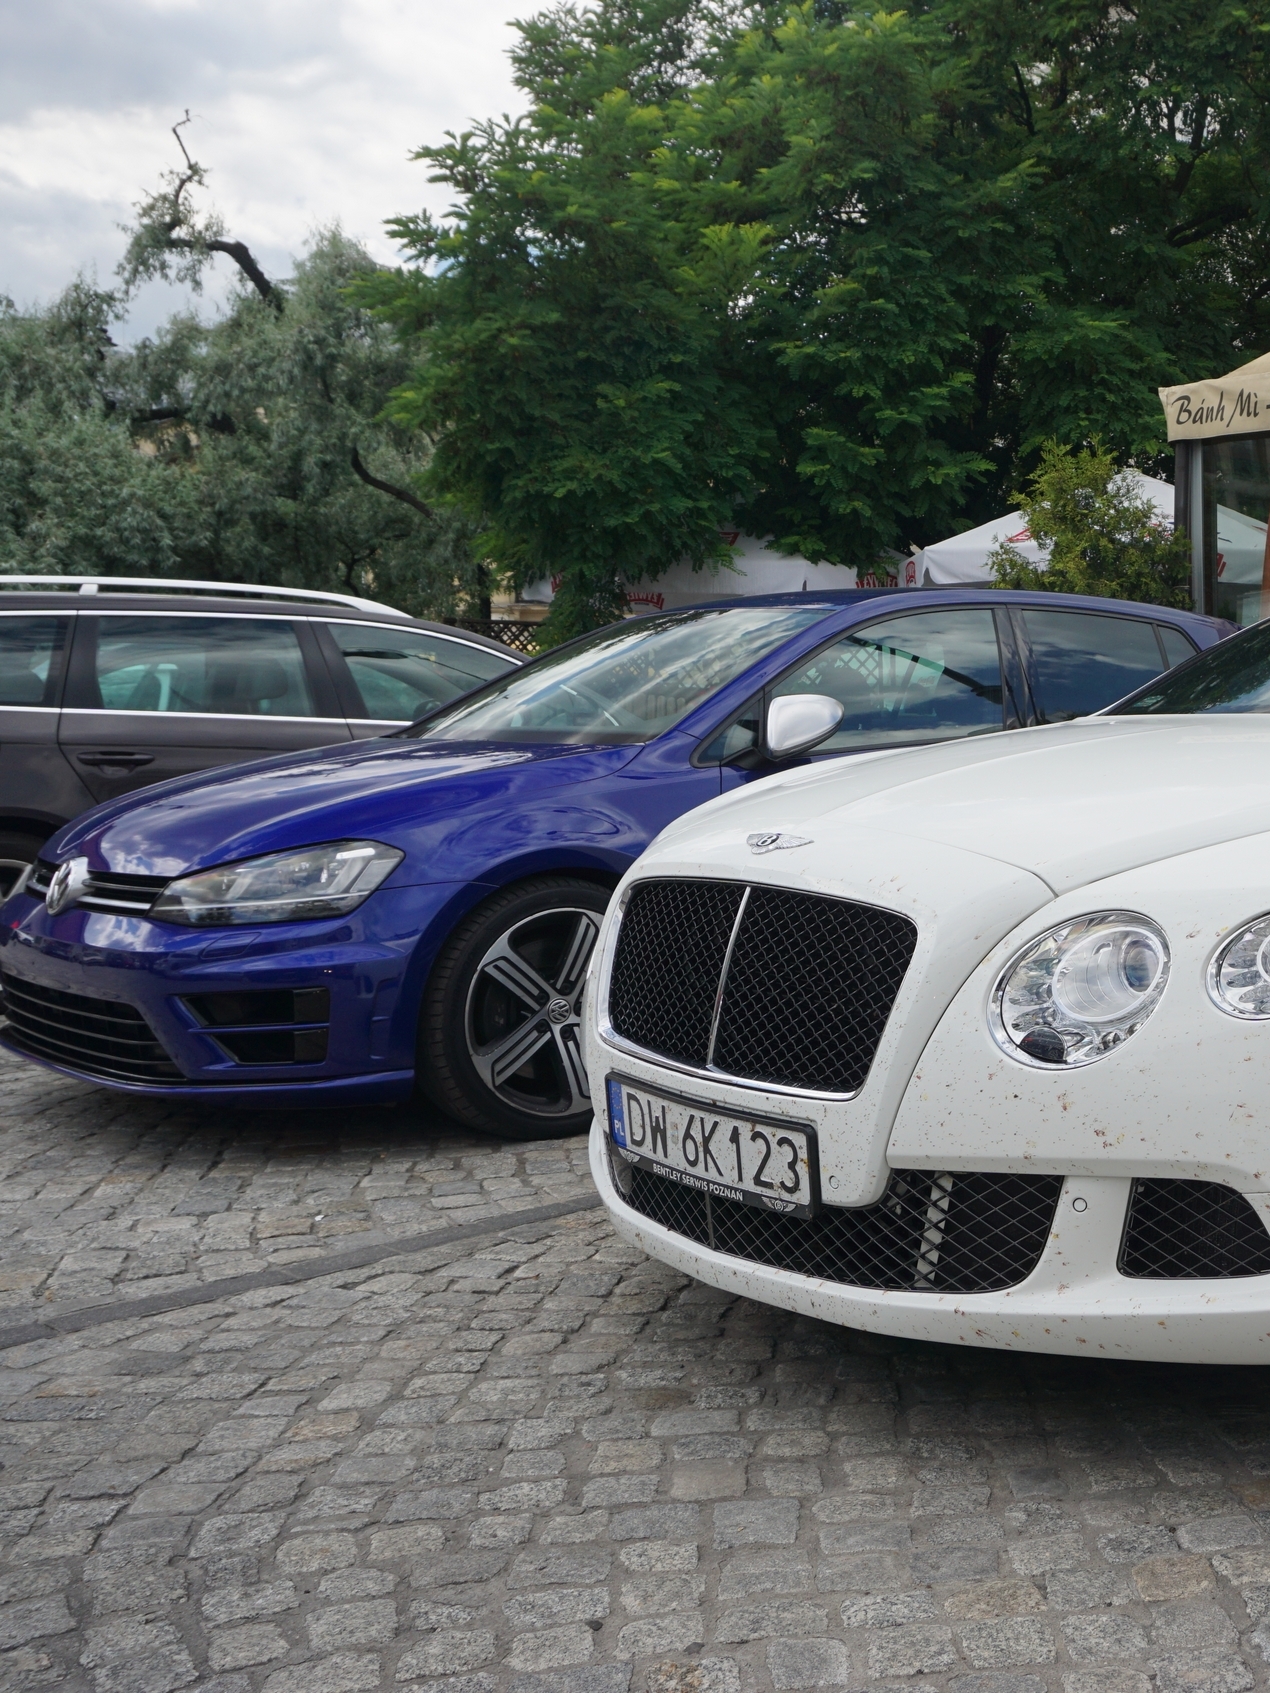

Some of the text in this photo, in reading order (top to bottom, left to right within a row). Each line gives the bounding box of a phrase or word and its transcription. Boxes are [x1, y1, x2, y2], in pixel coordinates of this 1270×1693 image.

[1172, 390, 1225, 426] Bánh
[1226, 387, 1260, 428] Mì
[613, 1119, 625, 1137] PL
[626, 1091, 801, 1195] DW 6K123
[652, 1163, 743, 1202] BENTLEY SERWIS POZNAŃ
